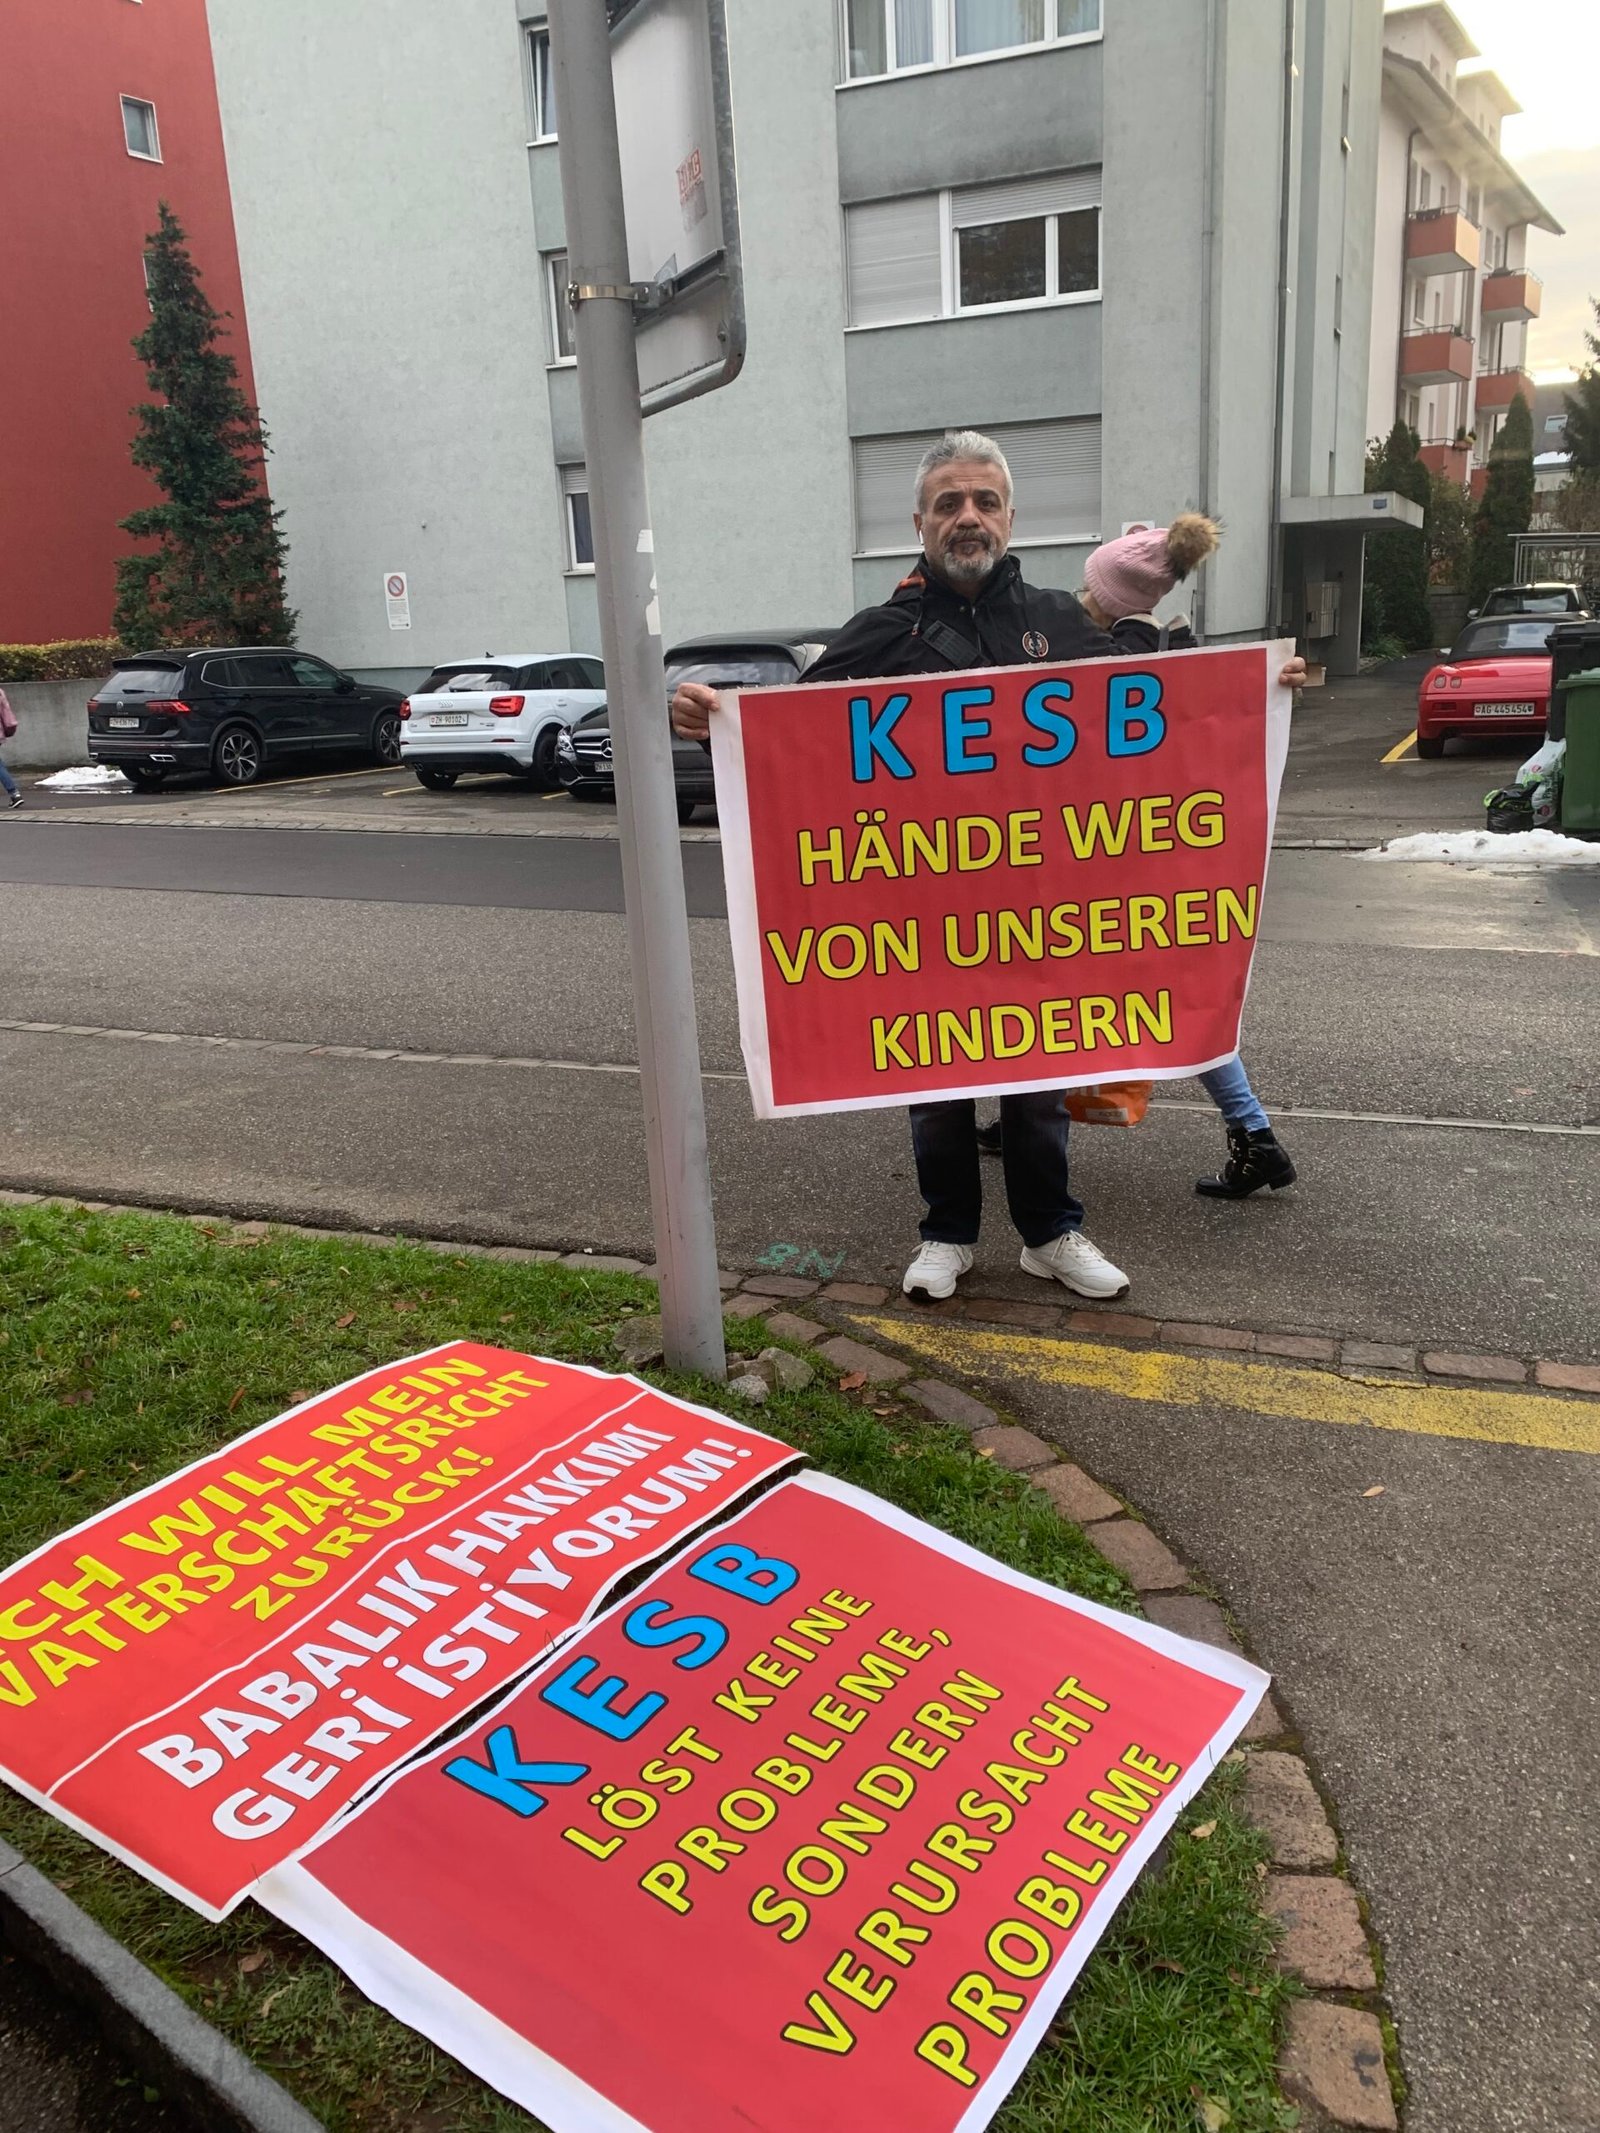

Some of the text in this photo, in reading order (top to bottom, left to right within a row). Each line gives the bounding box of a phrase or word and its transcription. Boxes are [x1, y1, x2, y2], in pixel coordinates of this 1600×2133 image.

[435, 716, 442, 724] ZH
[798, 790, 1225, 887] HÄNDE WEG
[848, 672, 1168, 784] KESB
[1481, 704, 1527, 714] AG 445454
[765, 884, 1258, 984] VON UNSEREN
[871, 989, 1173, 1073] KINDERN
[0, 1358, 489, 1656] CH WILL MEIN
[0, 1370, 550, 1707] VATERSCHAFTSRECHT
[138, 1422, 676, 1789] BABALIK HAKKIMI
[230, 1446, 494, 1621] ZURÜCK!
[441, 1543, 800, 1818] KESB
[561, 1588, 875, 1861] LÖST KEINE
[638, 1627, 952, 1917] PROBLEME,
[749, 1669, 1004, 1943] SONDERN
[780, 1675, 1110, 2057] VERURSACHT
[914, 1743, 1181, 2089] PROBLEME
